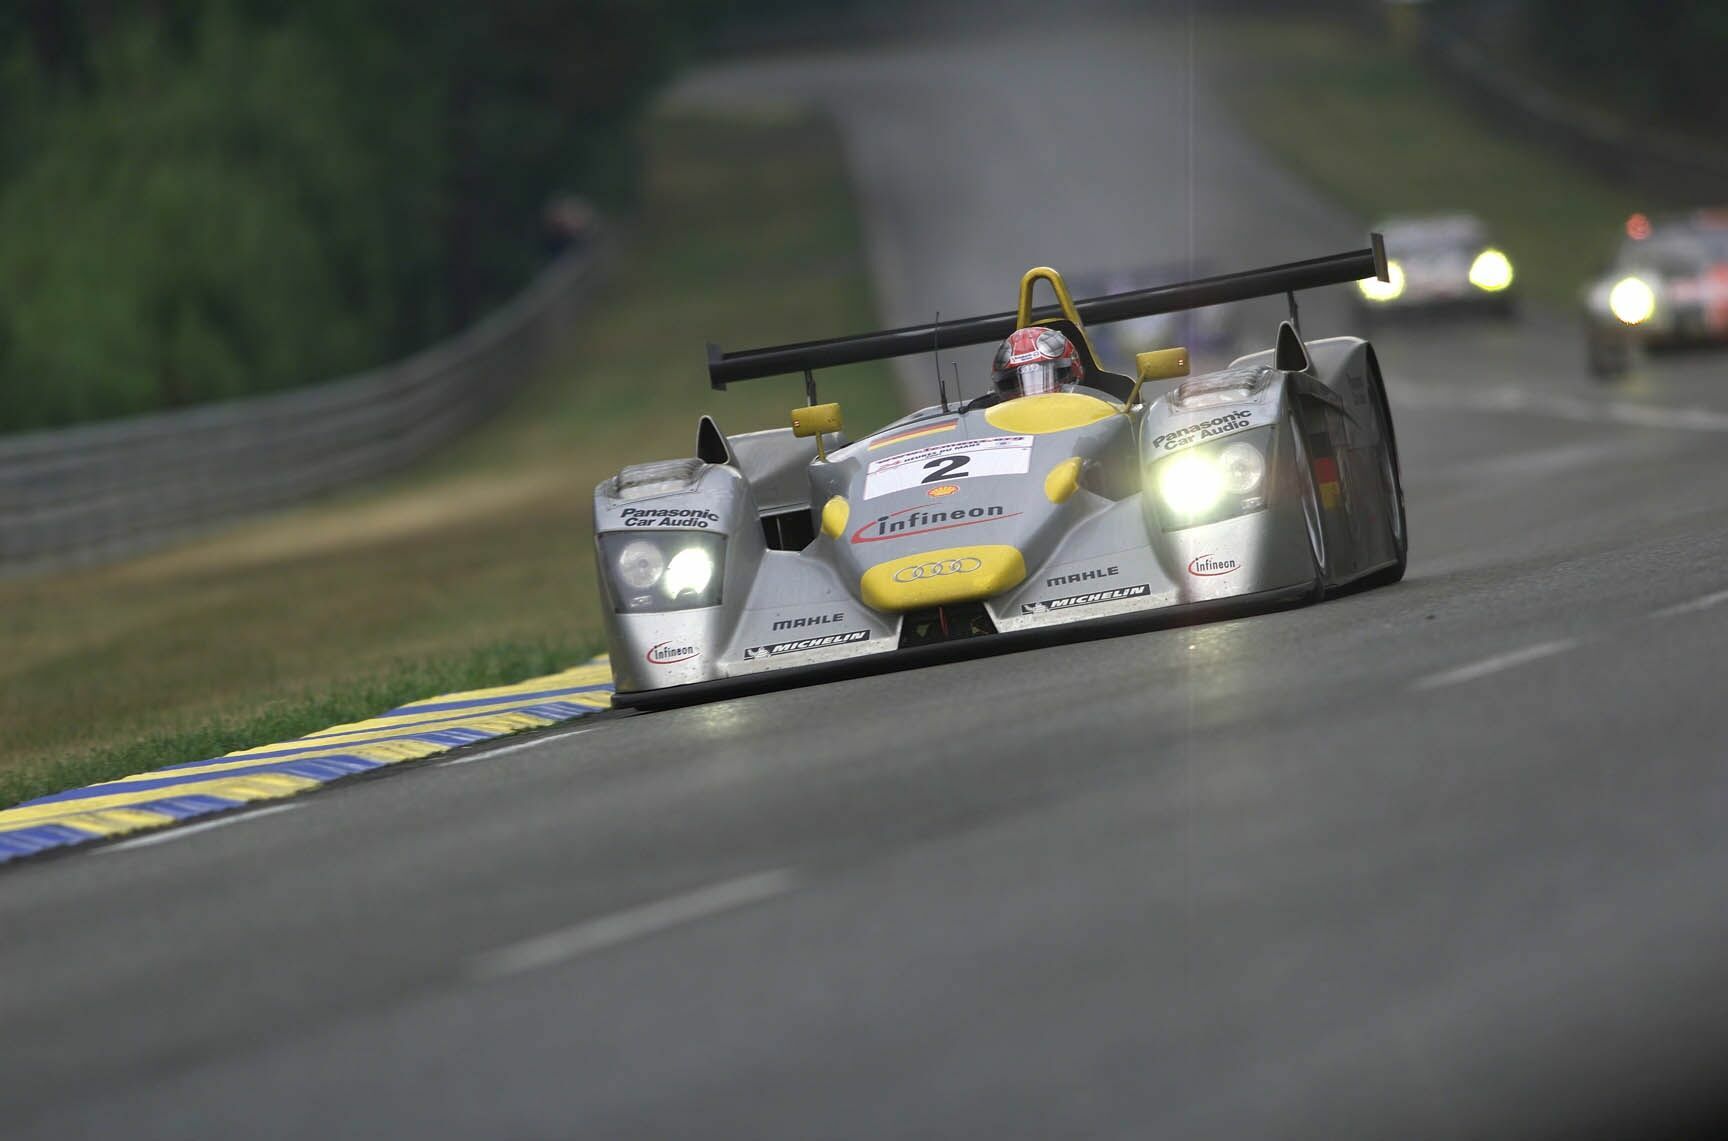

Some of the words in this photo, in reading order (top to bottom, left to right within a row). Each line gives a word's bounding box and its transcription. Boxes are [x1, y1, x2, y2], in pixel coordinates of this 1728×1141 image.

[1152, 409, 1252, 449] Panasonic
[1163, 435, 1195, 451] Car
[1201, 420, 1250, 439] Audio
[920, 455, 971, 484] 2
[620, 507, 720, 522] Panasonic
[624, 516, 656, 528] Car
[658, 516, 709, 529] Audio
[1046, 566, 1120, 588] MAHLE
[1049, 585, 1146, 609] MICHELIN
[772, 612, 845, 632] MAHLE
[770, 631, 866, 654] MICHELIN
